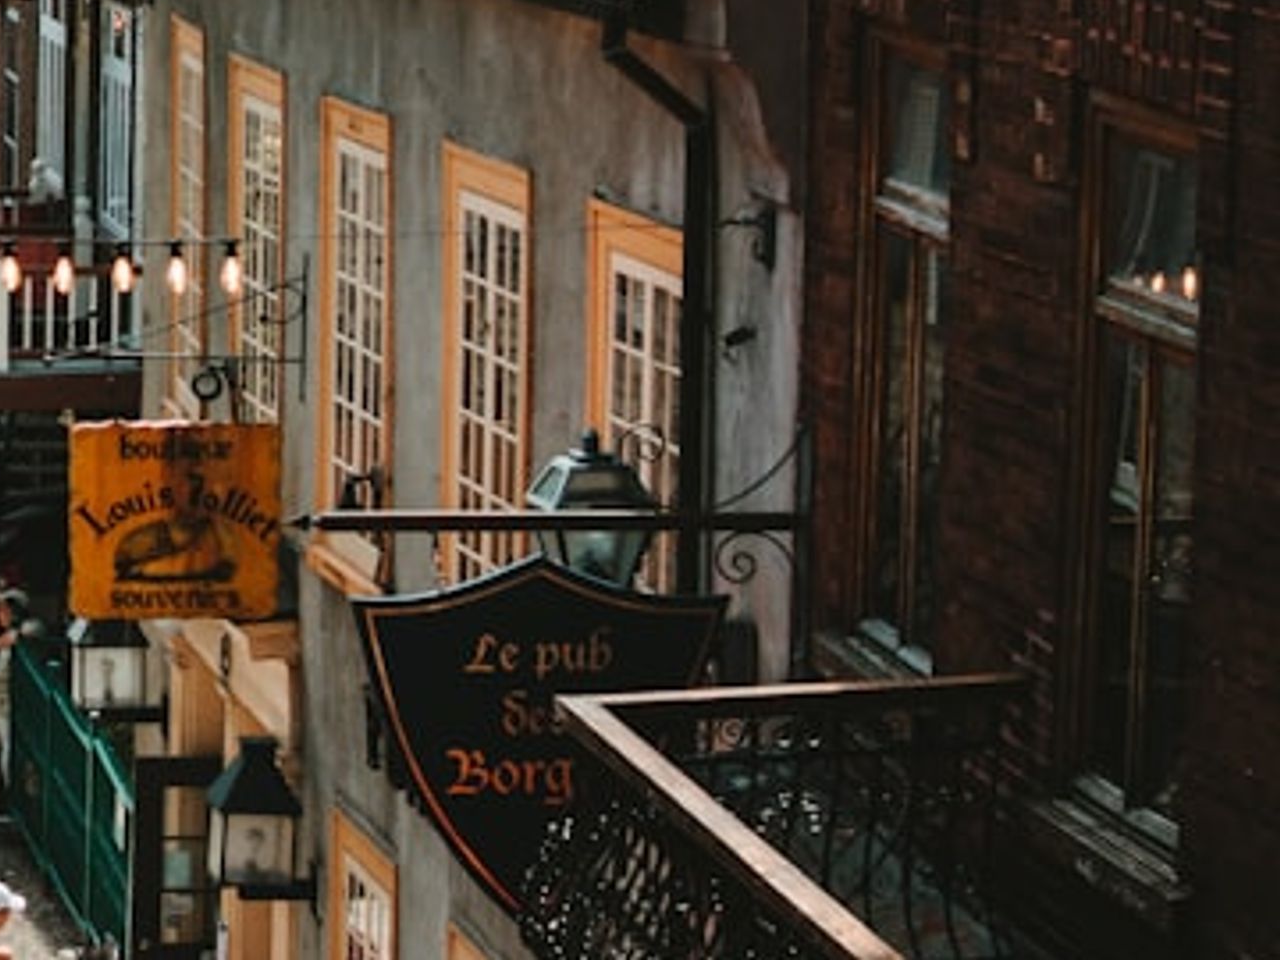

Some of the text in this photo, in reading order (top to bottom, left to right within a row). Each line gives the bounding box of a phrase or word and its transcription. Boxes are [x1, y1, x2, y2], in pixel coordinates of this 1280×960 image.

[77, 481, 175, 539] Louis
[462, 626, 613, 680] Le pub
[445, 748, 573, 806] Borg
